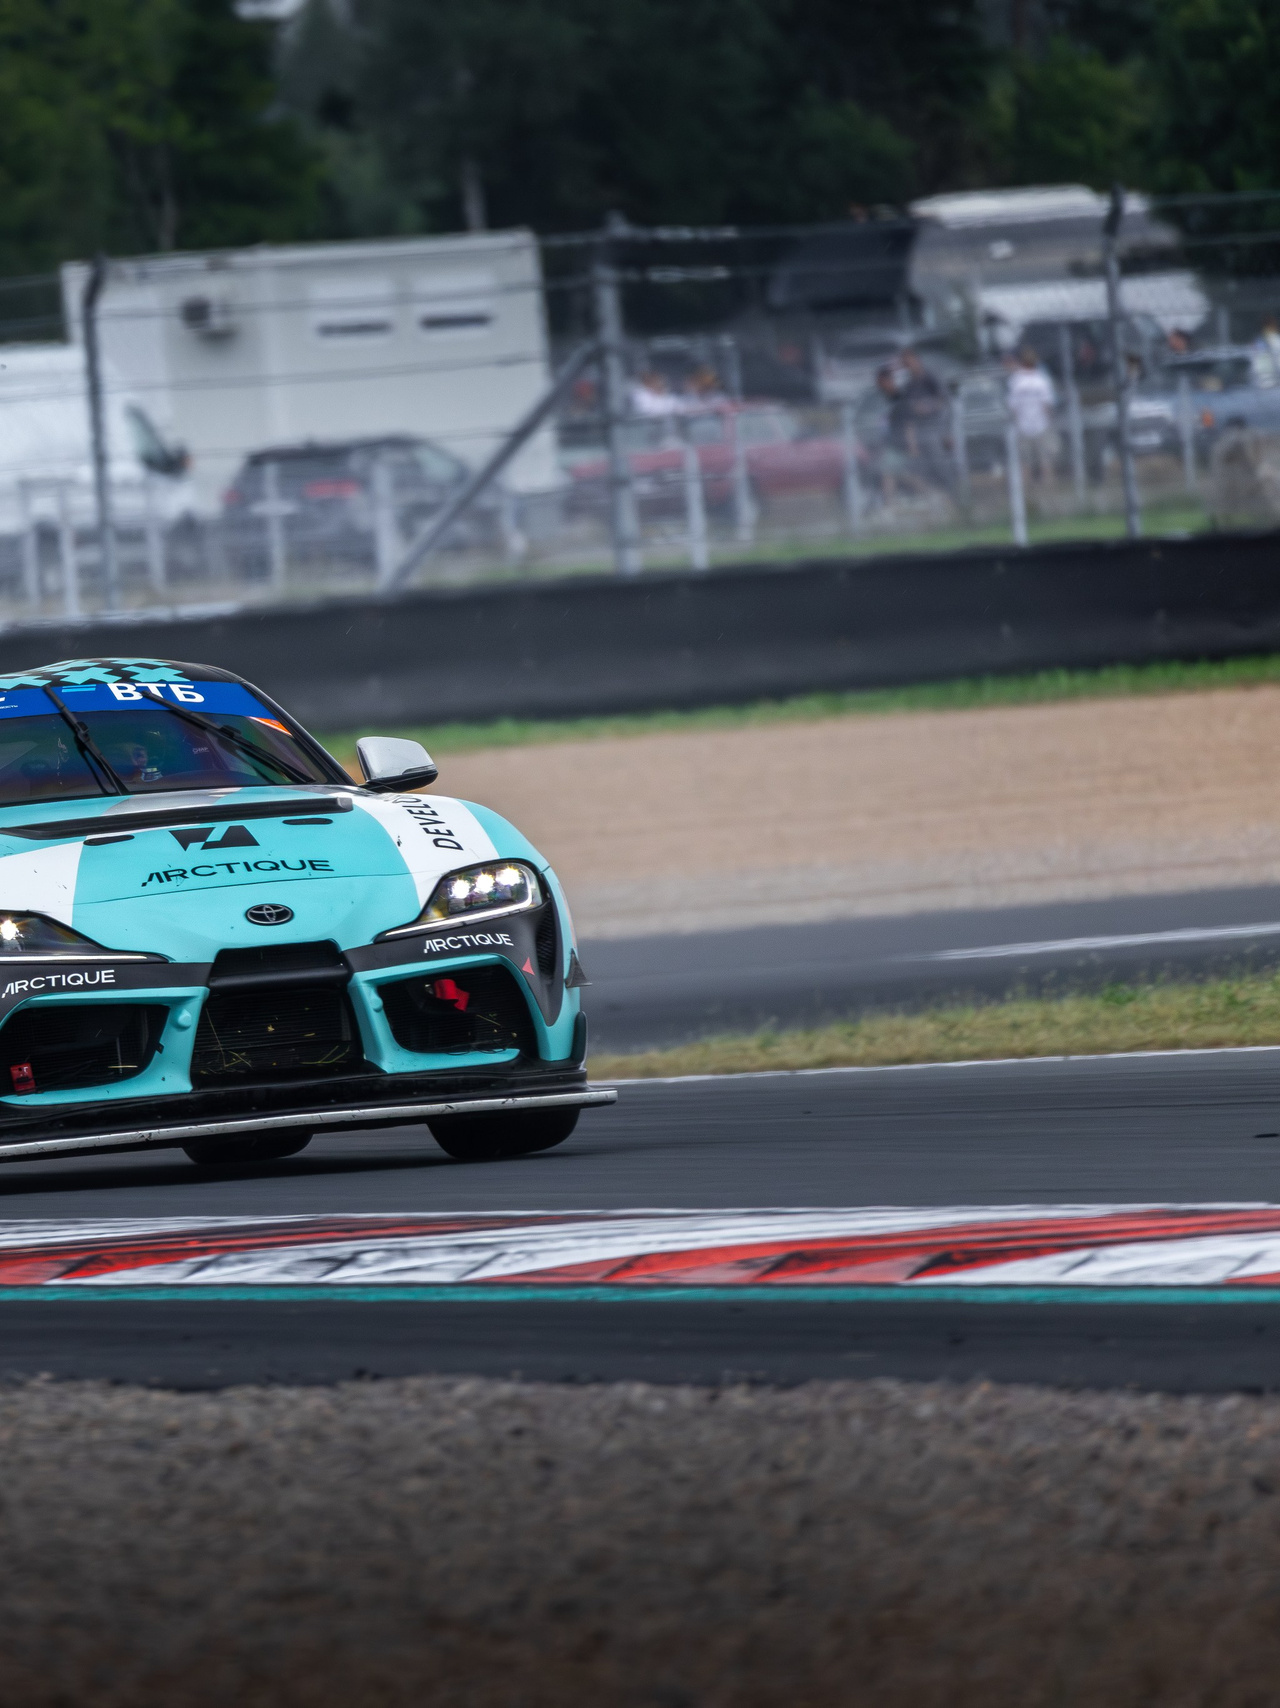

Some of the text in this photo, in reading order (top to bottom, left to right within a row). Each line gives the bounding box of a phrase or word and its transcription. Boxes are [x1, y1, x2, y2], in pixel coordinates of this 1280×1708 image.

[106, 682, 205, 703] ВТБ
[141, 859, 335, 887] ARCTIQUE
[423, 933, 514, 954] ARCTIQUE
[1, 969, 116, 999] ARCTIQUE
